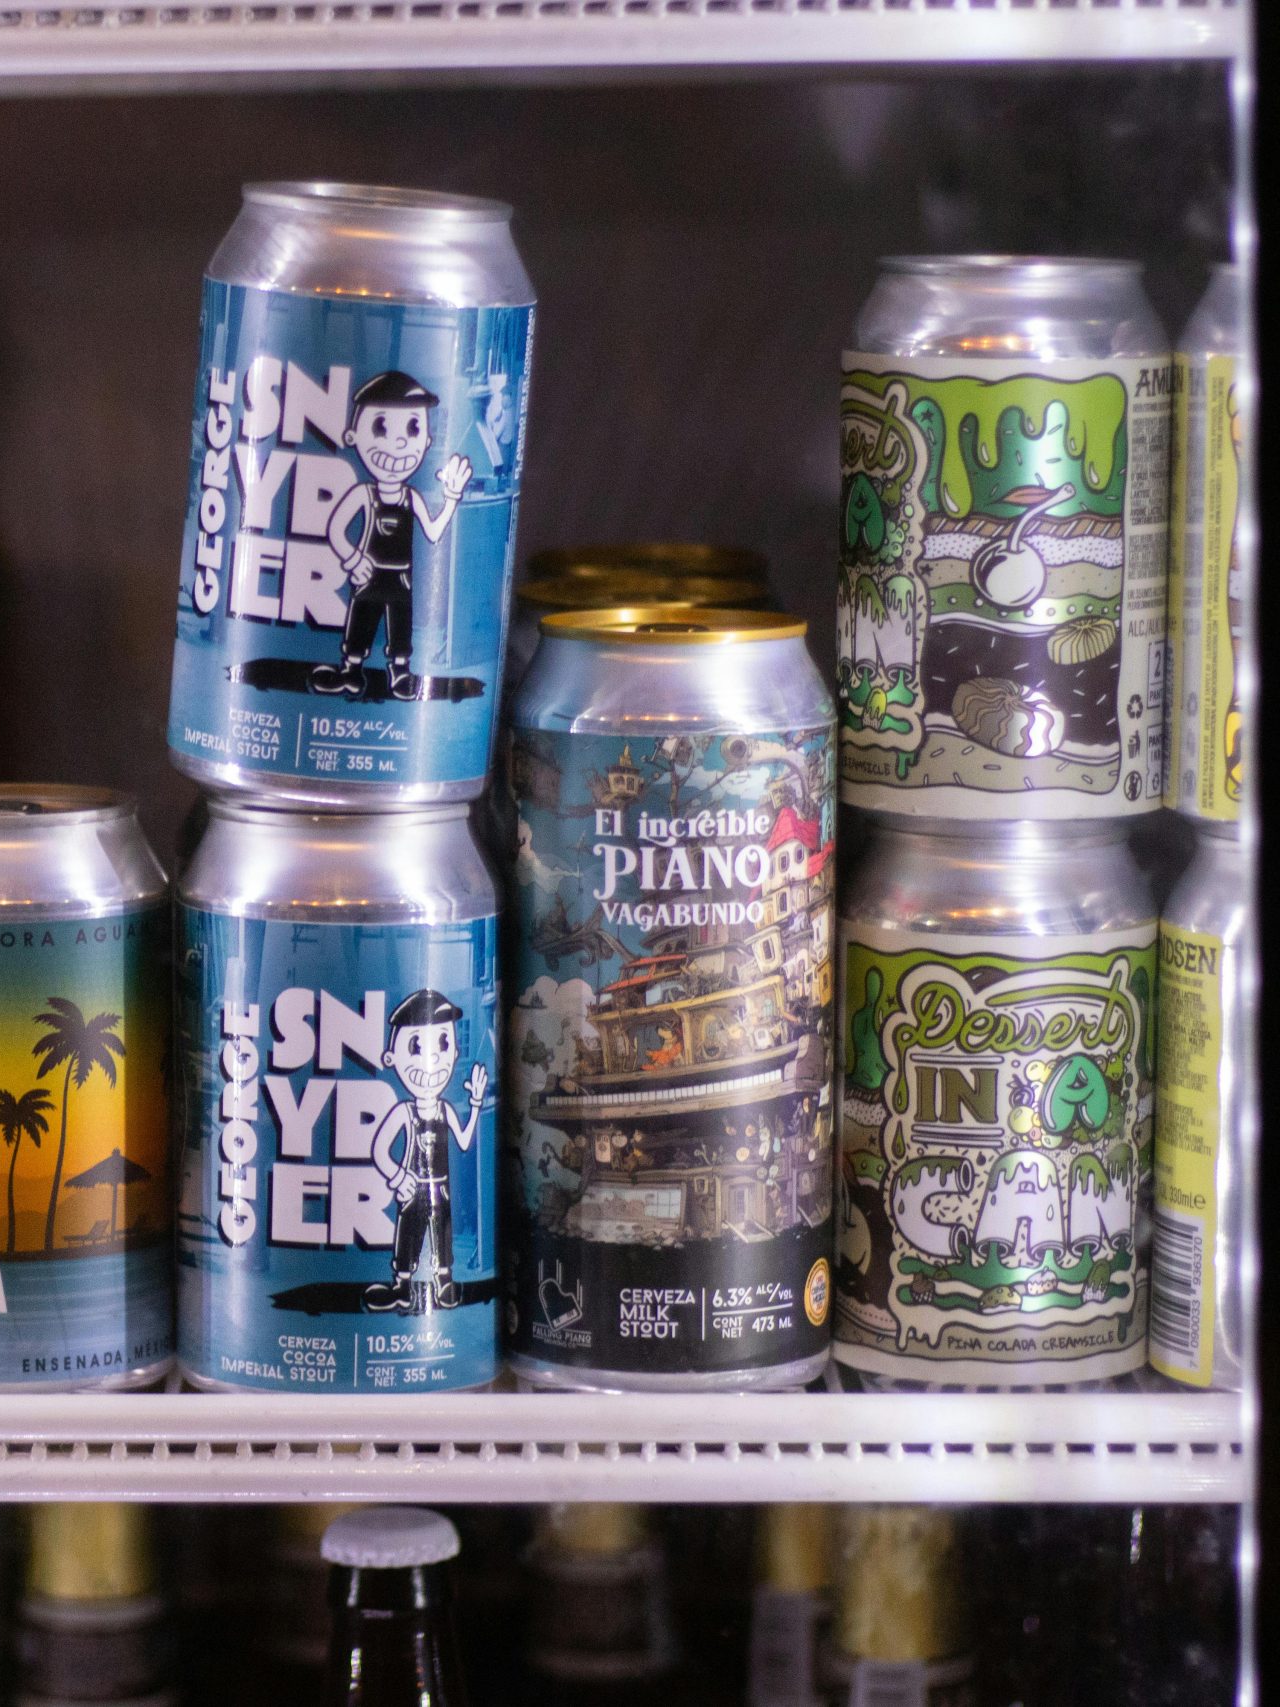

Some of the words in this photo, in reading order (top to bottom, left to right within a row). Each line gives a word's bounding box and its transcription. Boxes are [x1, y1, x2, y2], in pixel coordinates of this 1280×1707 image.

[194, 368, 237, 615] GEORGE
[229, 709, 280, 728] CERVEZA
[311, 717, 360, 738] 10.5%
[184, 727, 231, 753] IMPERIAL
[236, 741, 280, 761] STOUT
[232, 724, 280, 744] COCOA
[347, 755, 373, 770] 355
[595, 809, 622, 838] El
[594, 845, 772, 899] PIANO
[601, 902, 764, 931] VAGABUNDO
[75, 923, 136, 944] AGUA
[900, 968, 1132, 1054] Dessert
[915, 1066, 999, 1124] IN
[1041, 1052, 1109, 1133] A
[222, 1001, 260, 1248] GEORGE
[891, 1149, 1133, 1258] CAN
[620, 1288, 695, 1304] CERVEZA
[713, 1287, 752, 1307] 6.3%
[620, 1304, 669, 1321] MILK
[713, 1316, 743, 1329] CONT
[620, 1322, 678, 1339] STOUT
[722, 1327, 743, 1339] NET
[752, 1316, 775, 1332] 473
[279, 1335, 336, 1350] CERVEZA
[367, 1334, 414, 1353] 10.5%
[987, 1338, 1037, 1351] COLADA
[1042, 1331, 1114, 1350] CREAMSICLE
[283, 1350, 336, 1367] COCOA
[221, 1356, 283, 1380] IMPERIAL
[290, 1367, 336, 1383] STOUT
[403, 1367, 426, 1383] 355
